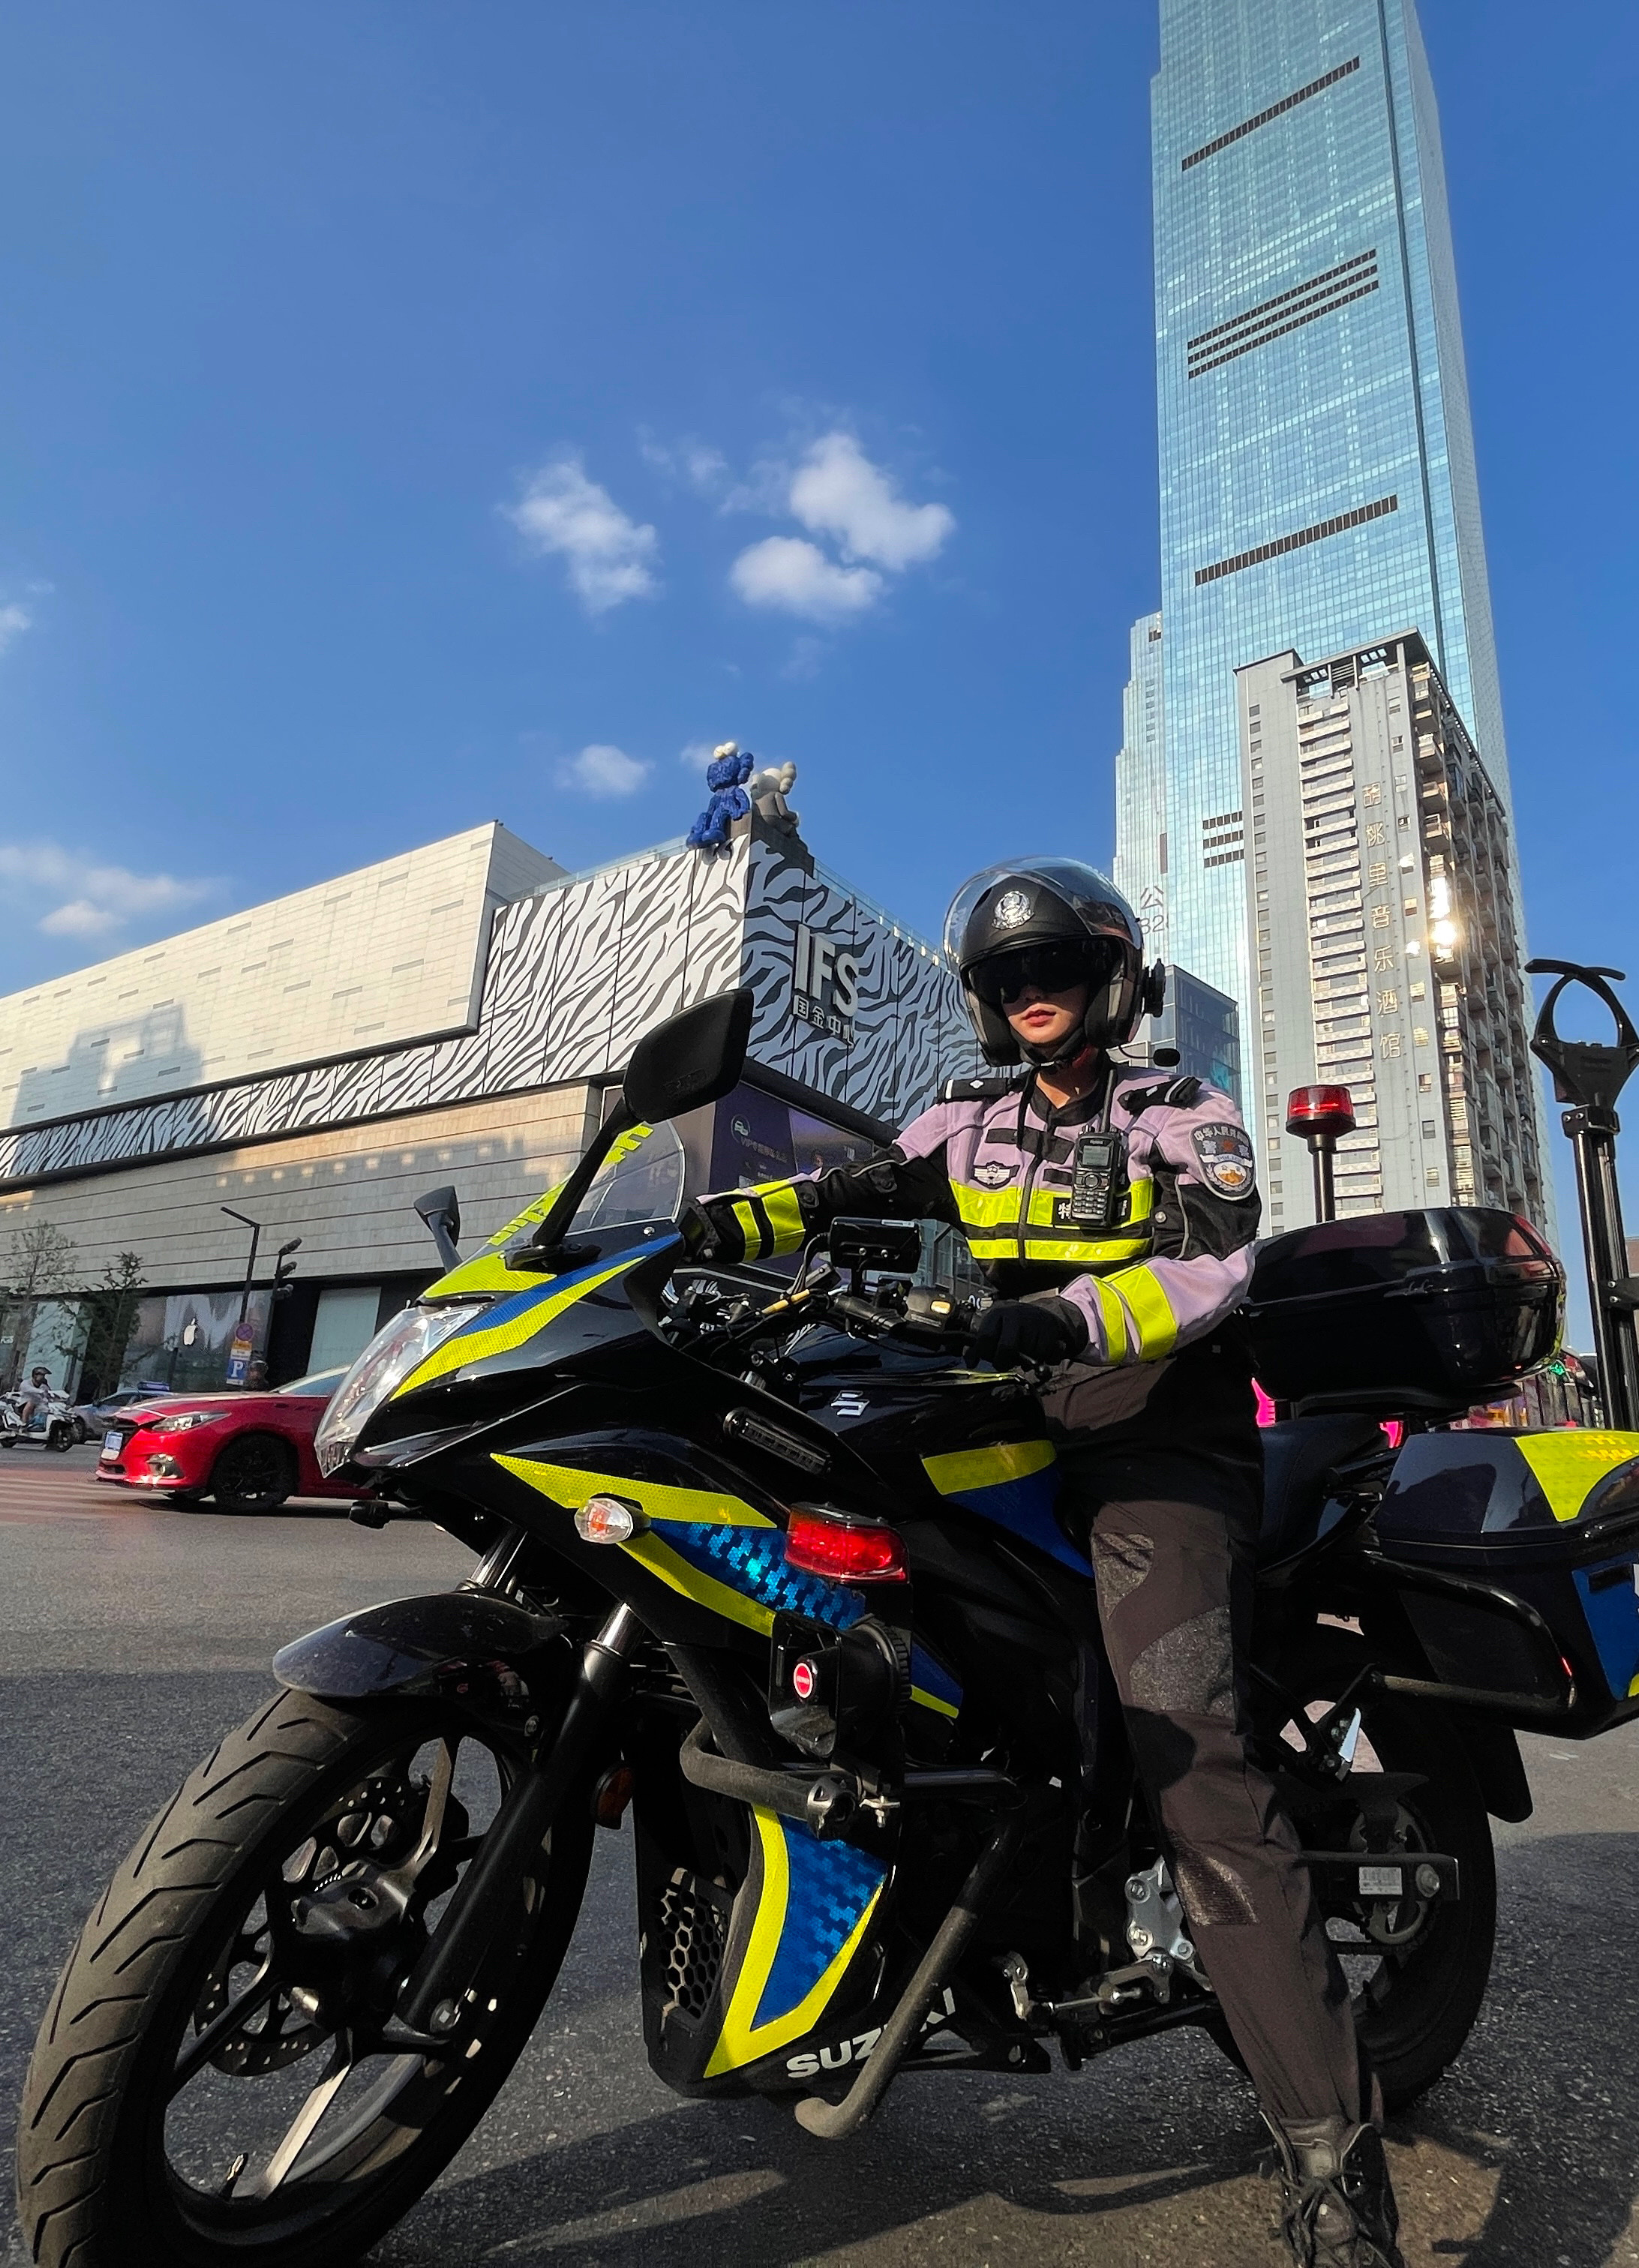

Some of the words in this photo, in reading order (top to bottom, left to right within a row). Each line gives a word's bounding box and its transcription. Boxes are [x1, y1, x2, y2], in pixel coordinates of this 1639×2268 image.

[1140, 886, 1164, 910] 公
[1362, 782, 1401, 1059] 胡桃里音乐酒馆
[794, 923, 860, 1017] IFS
[793, 995, 855, 1049] 国金中心
[231, 1360, 244, 1378] P
